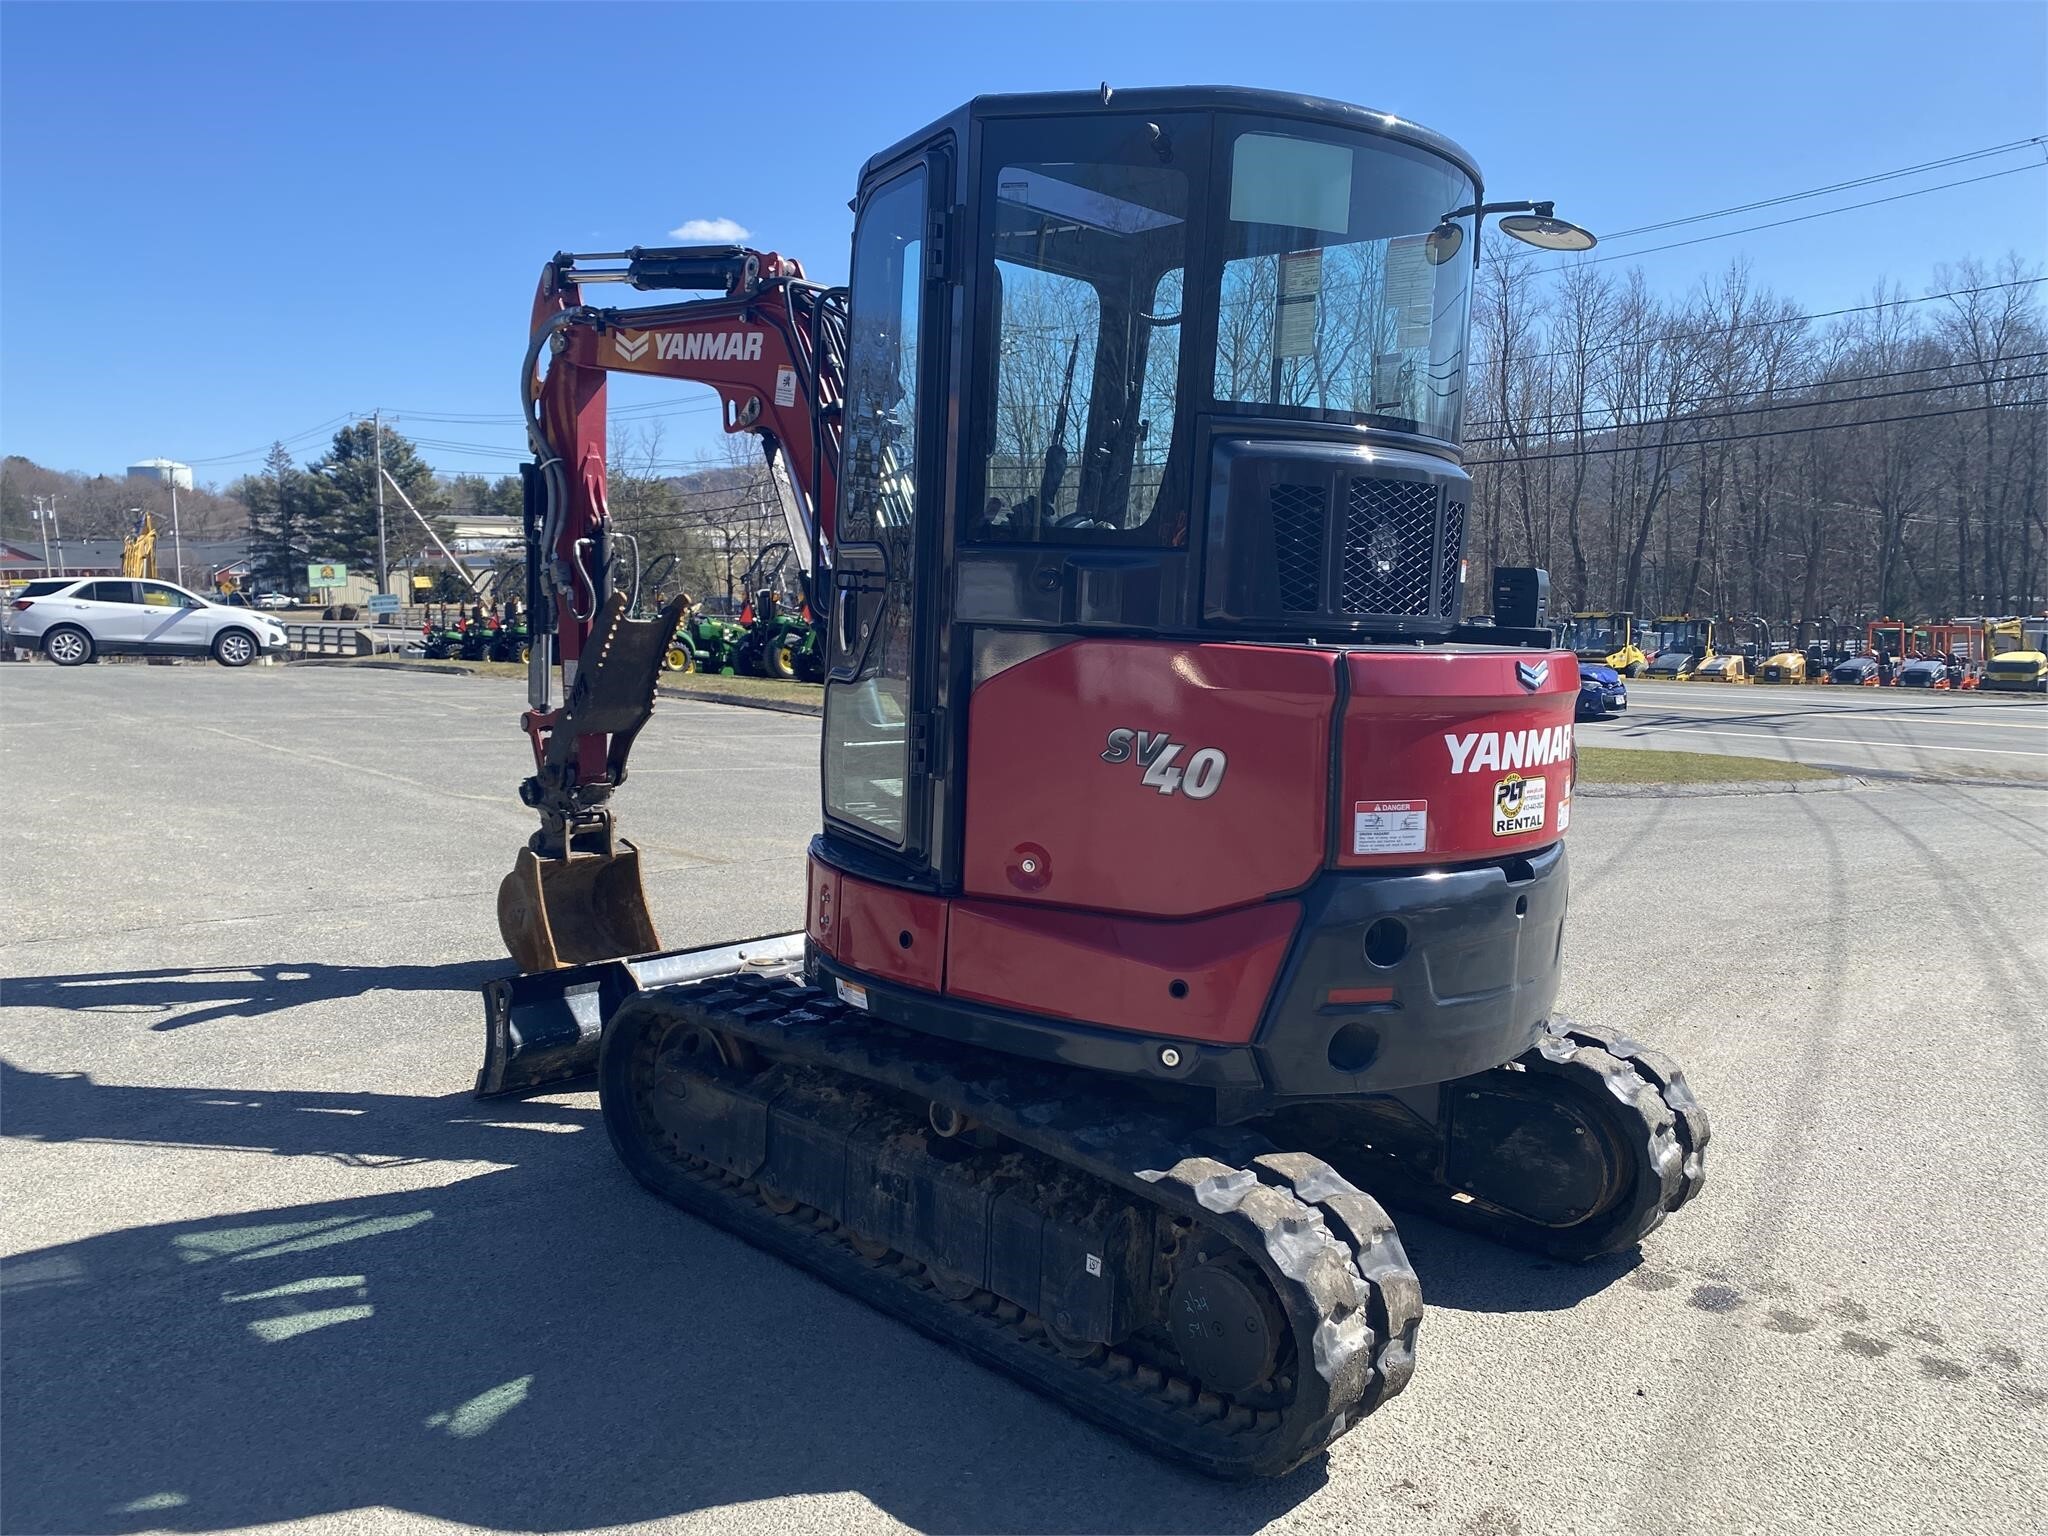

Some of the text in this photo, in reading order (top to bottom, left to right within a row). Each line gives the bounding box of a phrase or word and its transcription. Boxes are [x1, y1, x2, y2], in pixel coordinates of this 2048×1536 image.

[655, 332, 763, 361] YANMAR
[1444, 723, 1571, 774] YANMAR
[1497, 780, 1527, 805] PLT
[1382, 803, 1411, 811] DANGER
[1496, 815, 1543, 832] RENTAL
